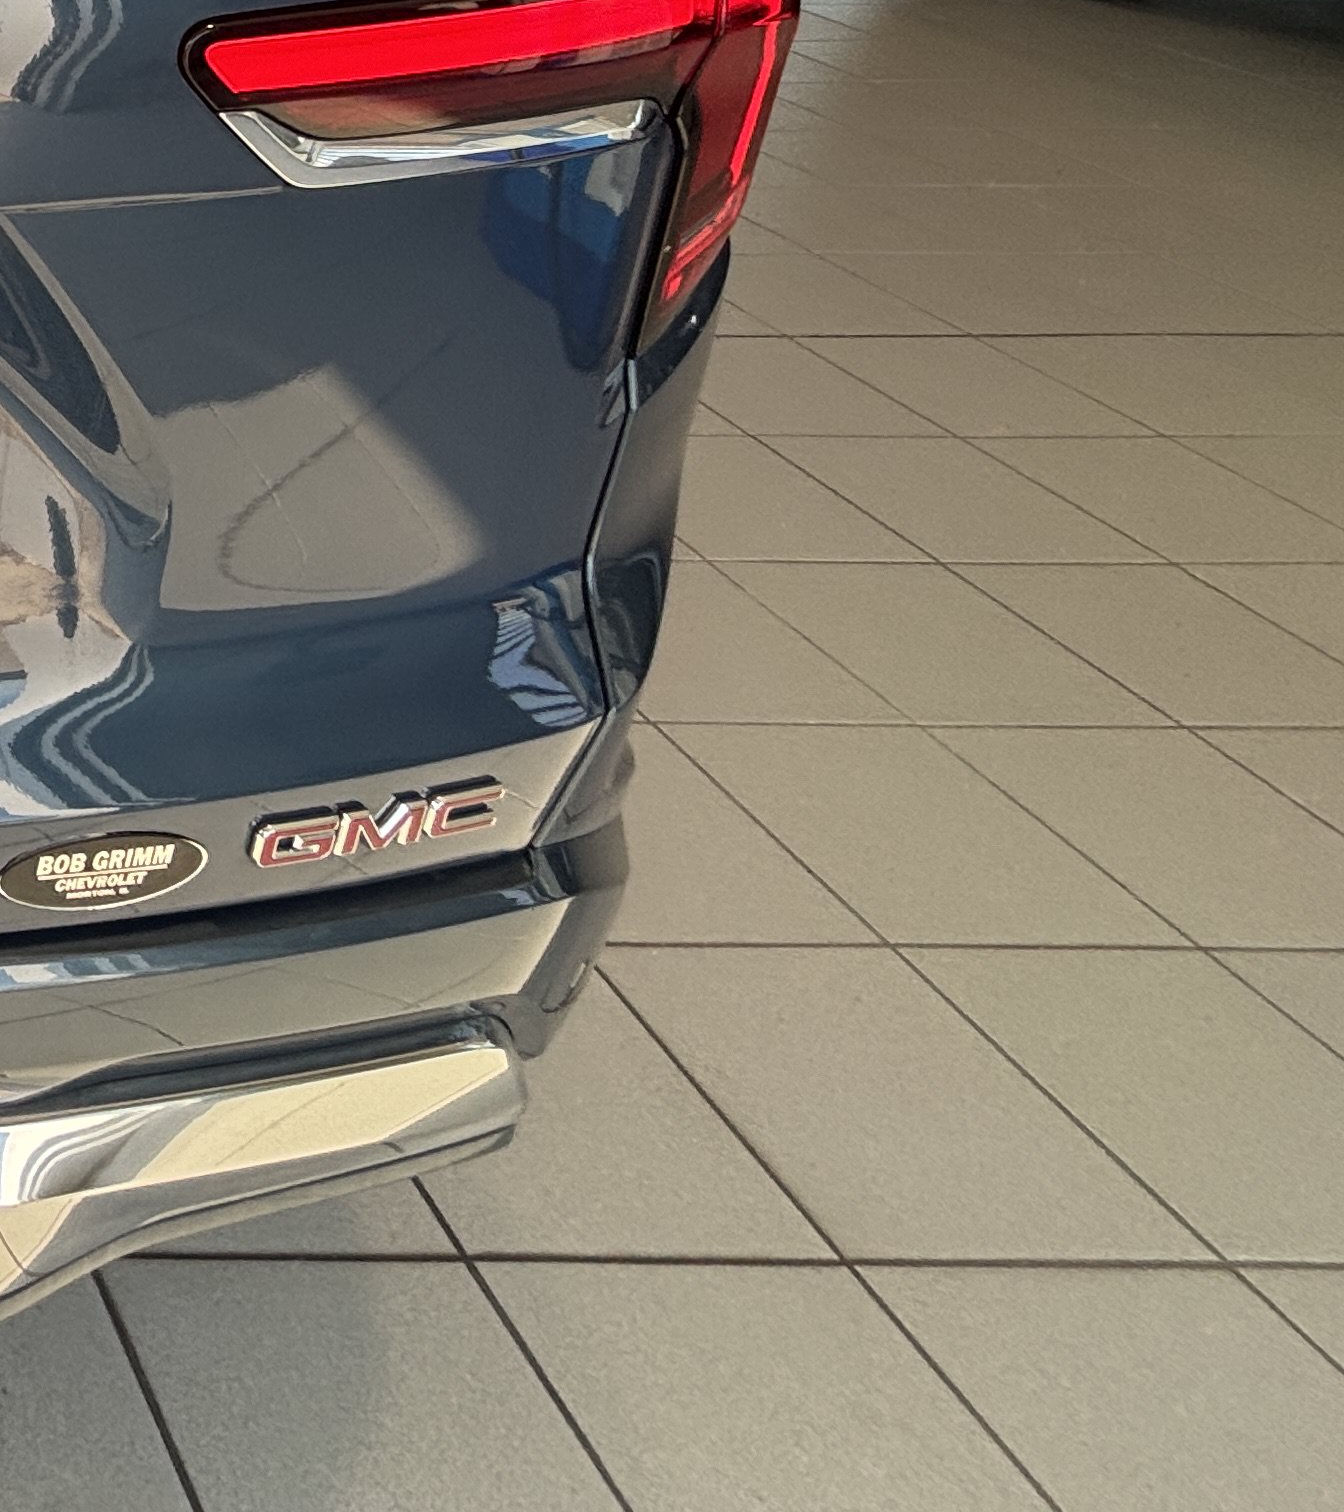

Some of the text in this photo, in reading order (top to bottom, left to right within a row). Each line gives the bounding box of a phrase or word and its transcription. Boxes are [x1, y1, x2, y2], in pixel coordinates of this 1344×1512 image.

[247, 775, 506, 868] GMC
[36, 843, 176, 877] BOB GRIMM
[54, 870, 149, 893] CHEVROLET
